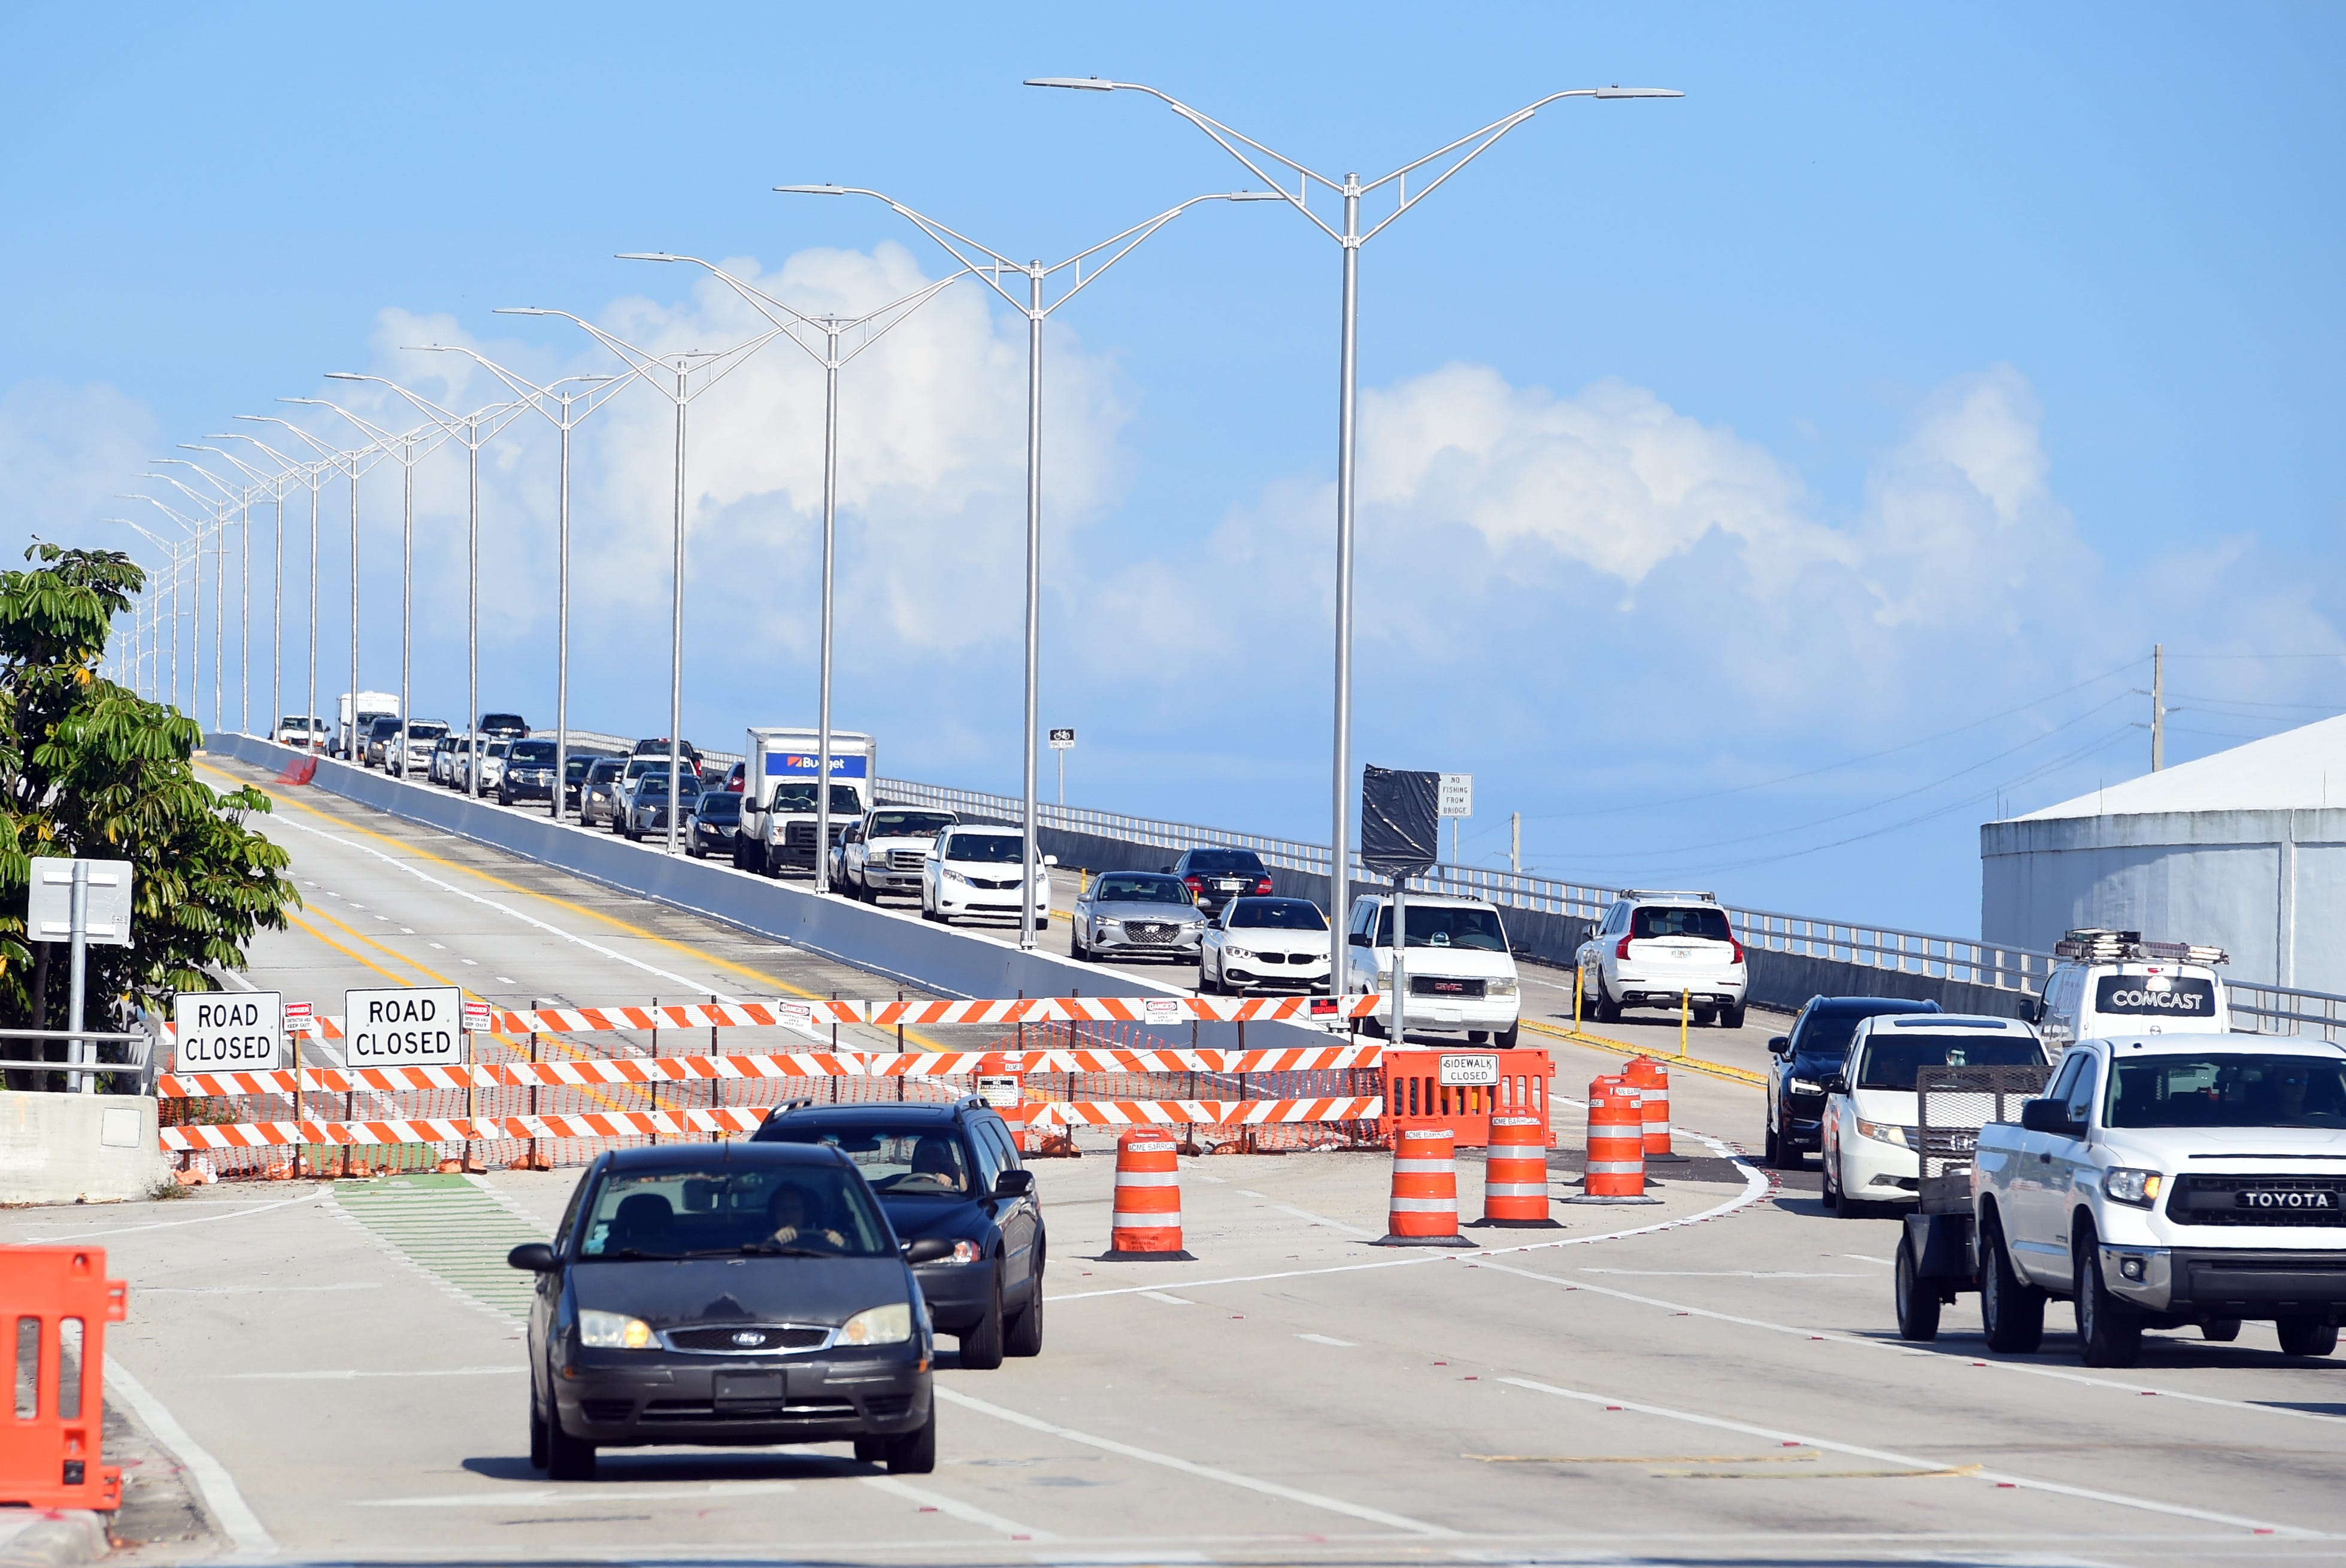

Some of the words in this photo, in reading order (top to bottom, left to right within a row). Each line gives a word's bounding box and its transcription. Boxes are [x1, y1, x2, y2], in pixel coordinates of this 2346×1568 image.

[803, 757, 845, 771] Buget
[1435, 982, 1463, 991] GMC
[2112, 990, 2203, 1009] COMCAST
[199, 1004, 257, 1027] ROAD
[370, 1000, 435, 1023] ROAD
[465, 1005, 487, 1014] DANGER
[783, 1004, 807, 1014] DANGER
[186, 1036, 270, 1060] CLOSED
[357, 1032, 450, 1056] CLOSED
[1445, 1059, 1492, 1068] SIDEWALK
[1451, 1072, 1487, 1080] CLOSED
[2246, 1193, 2329, 1207] TOYOTA
